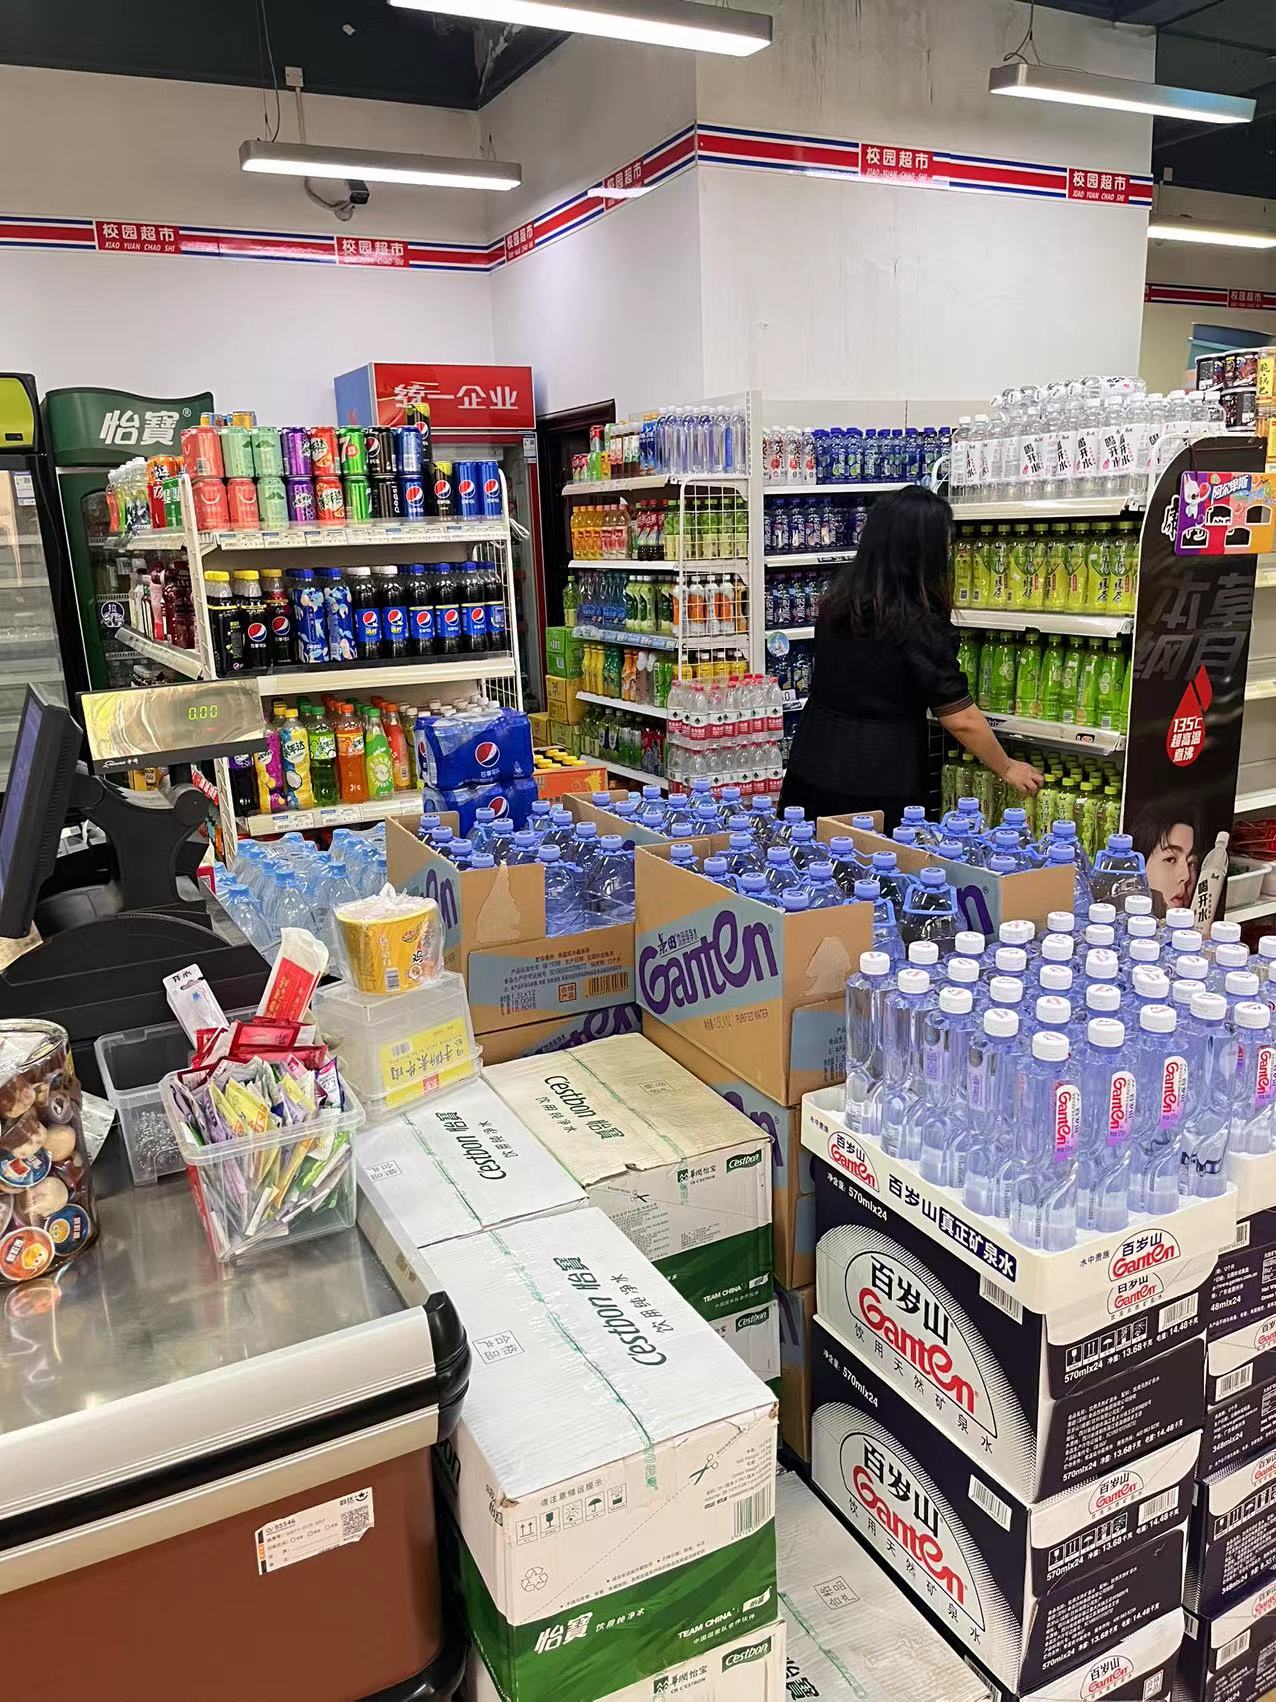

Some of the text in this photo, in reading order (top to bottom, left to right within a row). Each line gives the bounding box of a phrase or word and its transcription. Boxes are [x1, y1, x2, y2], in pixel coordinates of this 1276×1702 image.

[866, 147, 929, 169] 校园超市
[1072, 189, 1084, 198] XIAO
[1086, 191, 1100, 200] YUAN
[1073, 171, 1126, 191] 校园超市
[102, 223, 175, 242] 校园超市
[104, 241, 120, 249] XIAO
[342, 238, 404, 256] 校园超市
[393, 381, 518, 410] 统一企业
[188, 705, 218, 721] 0.00
[1171, 731, 1200, 748] 超高温
[639, 910, 778, 1014] Ganten
[1257, 1050, 1272, 1095] Ganten
[1162, 1061, 1178, 1113] Ganten
[1110, 1077, 1126, 1129] Ganten
[1056, 1091, 1072, 1145] Ganten
[837, 1134, 865, 1162] 百岁山
[831, 1143, 876, 1188] Ganten
[889, 1173, 1015, 1278] 百岁山 真正矿泉水
[1080, 1250, 1110, 1267] 水中贵族
[1122, 1232, 1163, 1257] 百岁山
[1113, 1243, 1175, 1278] Ganten
[703, 1285, 742, 1303] TEAM CHINA
[871, 1255, 949, 1346] 百岁山
[1114, 1284, 1156, 1309] Ganten
[859, 1287, 975, 1415] Ganten
[855, 1322, 993, 1454] 饮用天然矿泉水
[541, 1478, 603, 1506] 请注意储运提示
[864, 1437, 939, 1539] 百岁山
[1096, 1482, 1136, 1508] Ganten
[1100, 1472, 1130, 1494] 百岁山
[853, 1465, 963, 1606] Ganten
[848, 1497, 981, 1646] 饮用天然矿泉水
[534, 1607, 645, 1654] 怡寶 饮用纯净水
[678, 1610, 732, 1639] TEAM CHINA
[1088, 1665, 1128, 1693] Ganten
[1090, 1657, 1120, 1681] 百岁山
